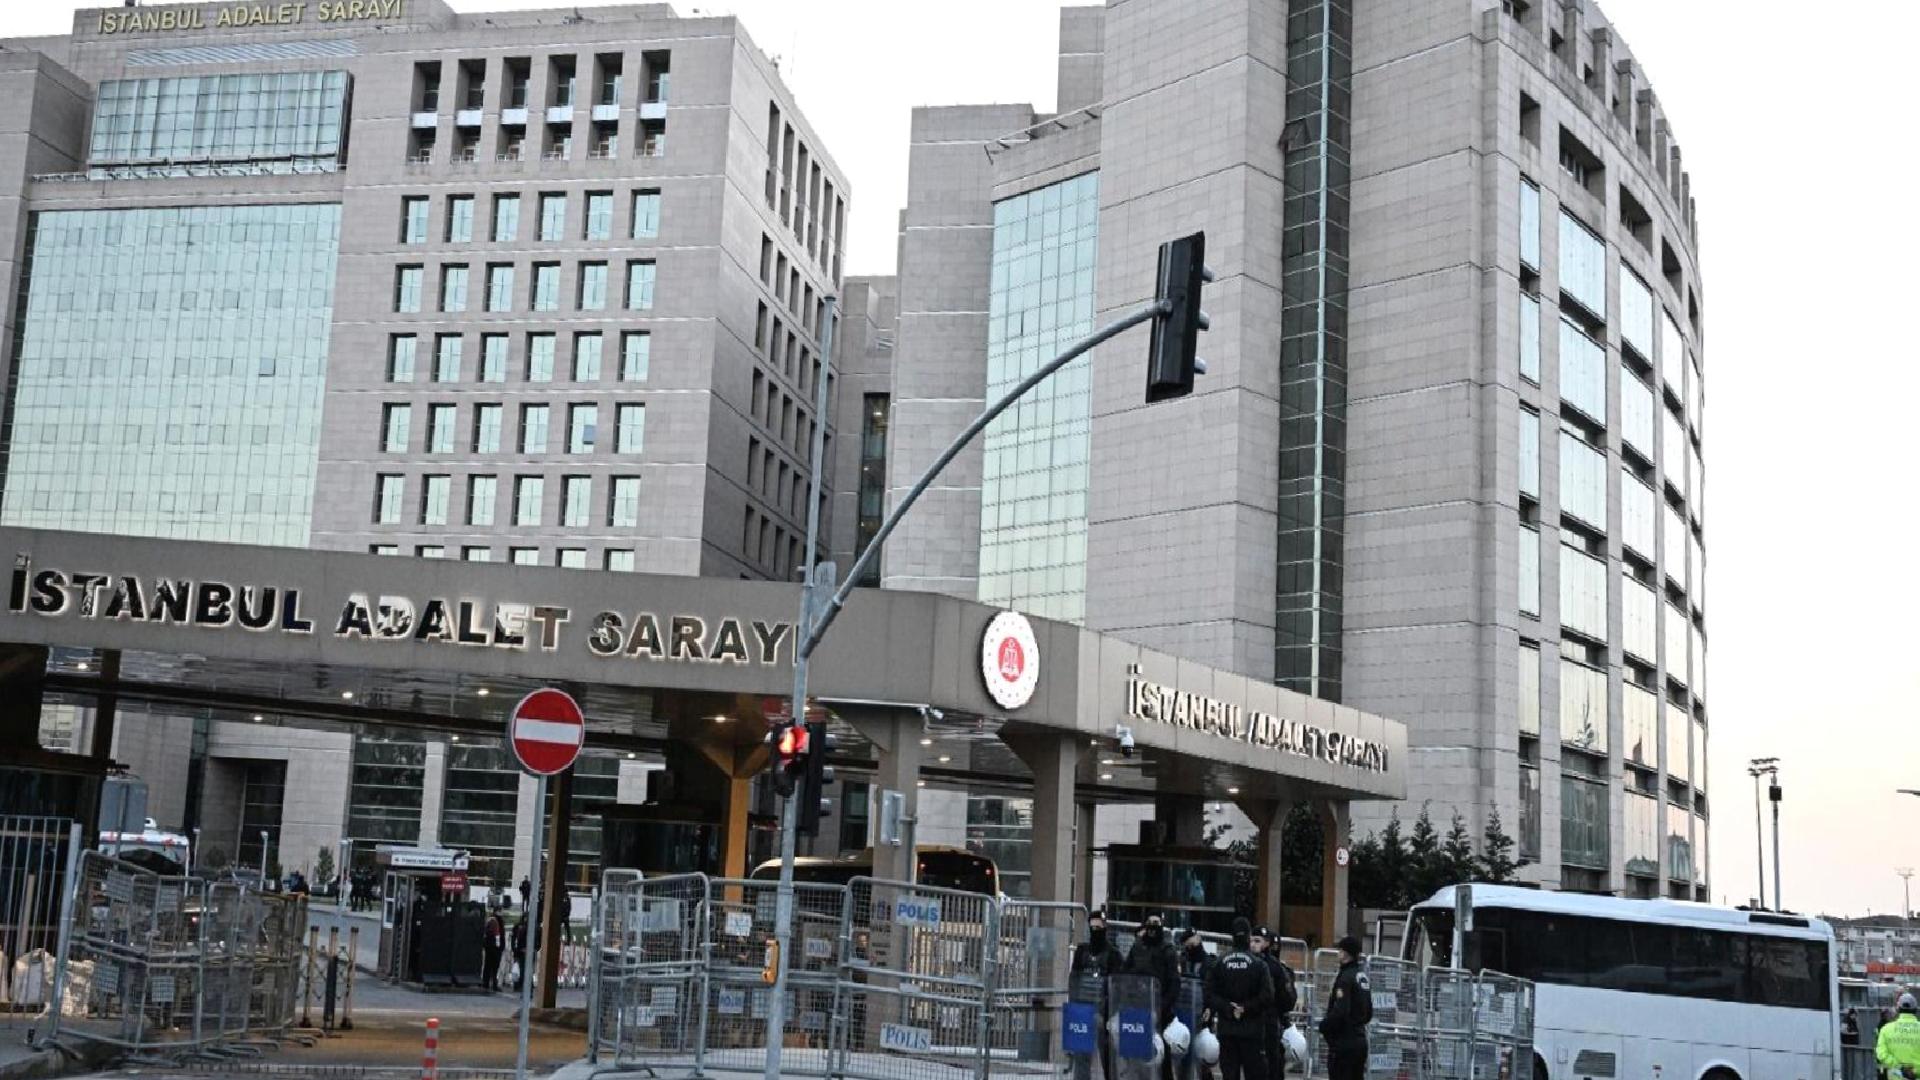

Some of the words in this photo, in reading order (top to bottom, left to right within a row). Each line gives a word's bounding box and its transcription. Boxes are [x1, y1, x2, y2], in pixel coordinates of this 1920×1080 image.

[98, 8, 205, 34] İSTANBUL
[216, 4, 306, 28] ADALET
[318, 0, 402, 20] SARAYI
[9, 552, 313, 635] İSTANBUL
[334, 591, 570, 652] ADALET
